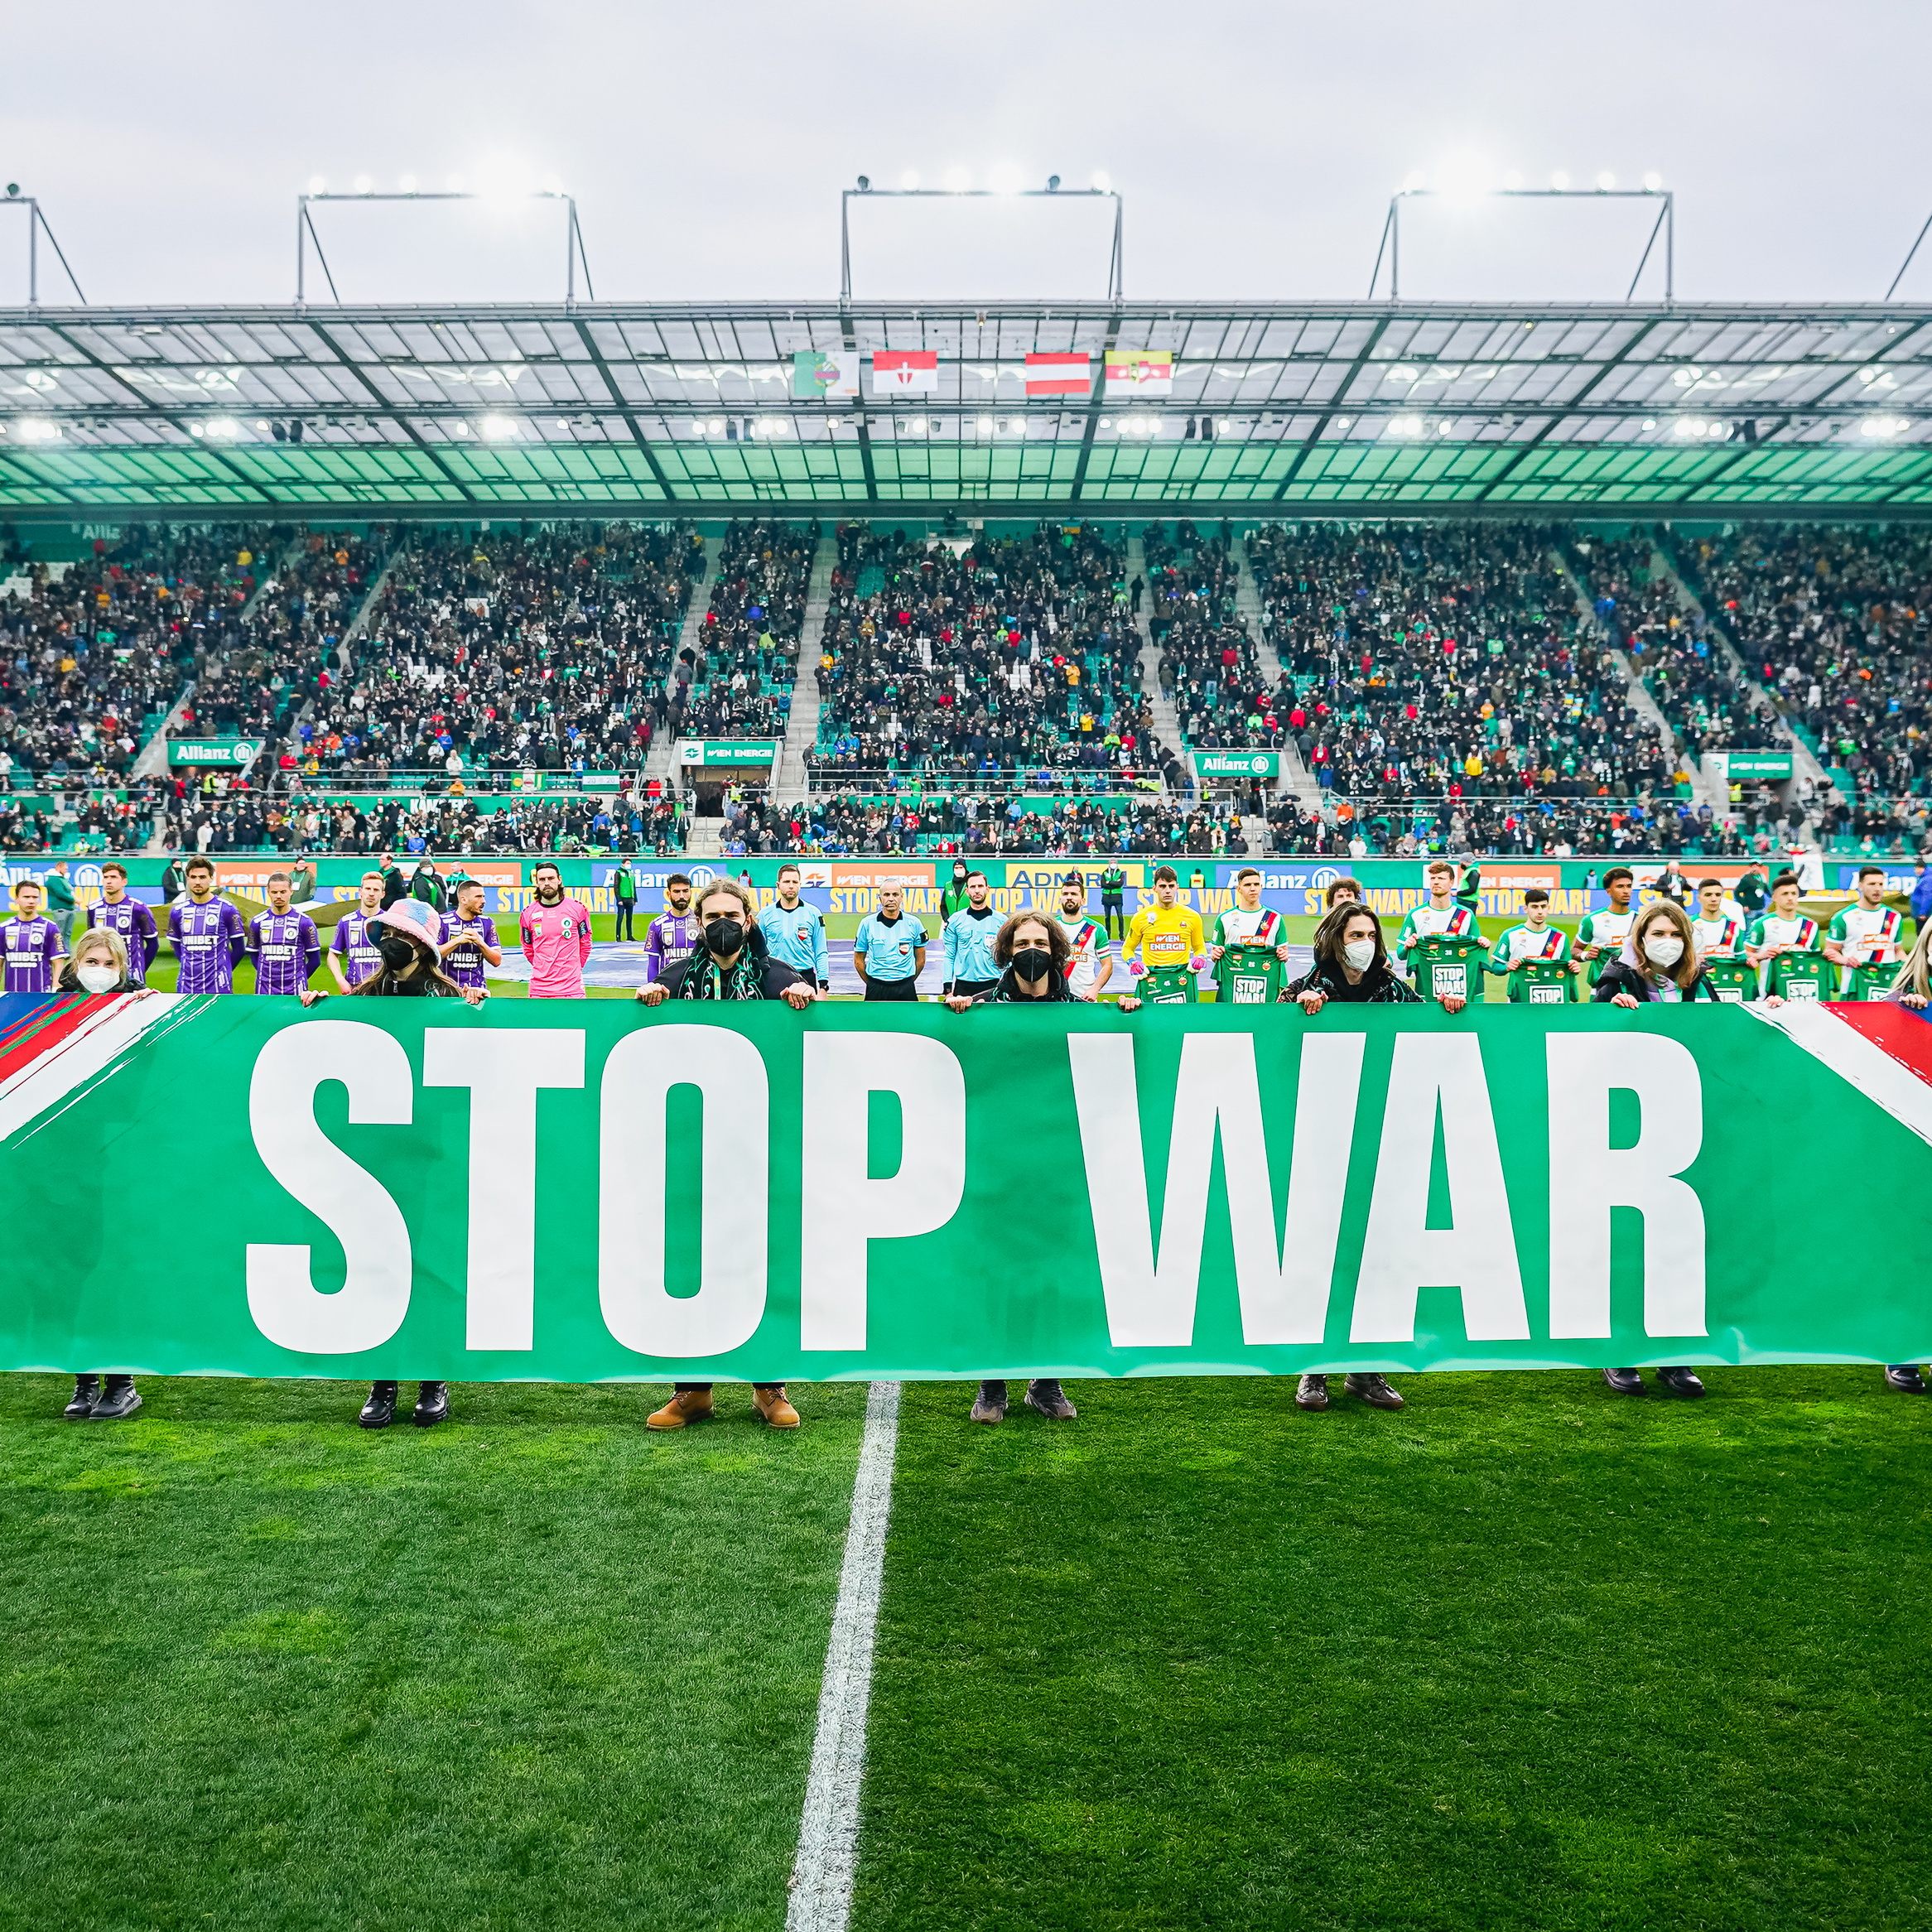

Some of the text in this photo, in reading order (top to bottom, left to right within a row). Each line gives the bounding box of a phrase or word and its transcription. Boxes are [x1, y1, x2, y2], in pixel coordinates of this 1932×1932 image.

[176, 745, 231, 759] Allianz
[1203, 758, 1249, 770] Allianz
[836, 875, 870, 885] WIEN
[1227, 870, 1307, 889] Aianz
[1500, 877, 1554, 887] ENERGIE
[498, 887, 537, 913] STO
[1365, 889, 1424, 914] WAR!
[182, 935, 219, 945] UNIBET
[262, 945, 297, 955] UNIBET
[349, 947, 381, 957] UNIBE
[664, 947, 694, 958] UNIBE
[1149, 942, 1185, 951] ENERGIE
[6, 952, 43, 961] UNIBET
[1435, 967, 1463, 981] STOP
[1236, 979, 1264, 993] STOP
[1435, 980, 1464, 994] WAR!
[1533, 990, 1561, 1003] STOP
[246, 1019, 1709, 1357] STOP WAR
